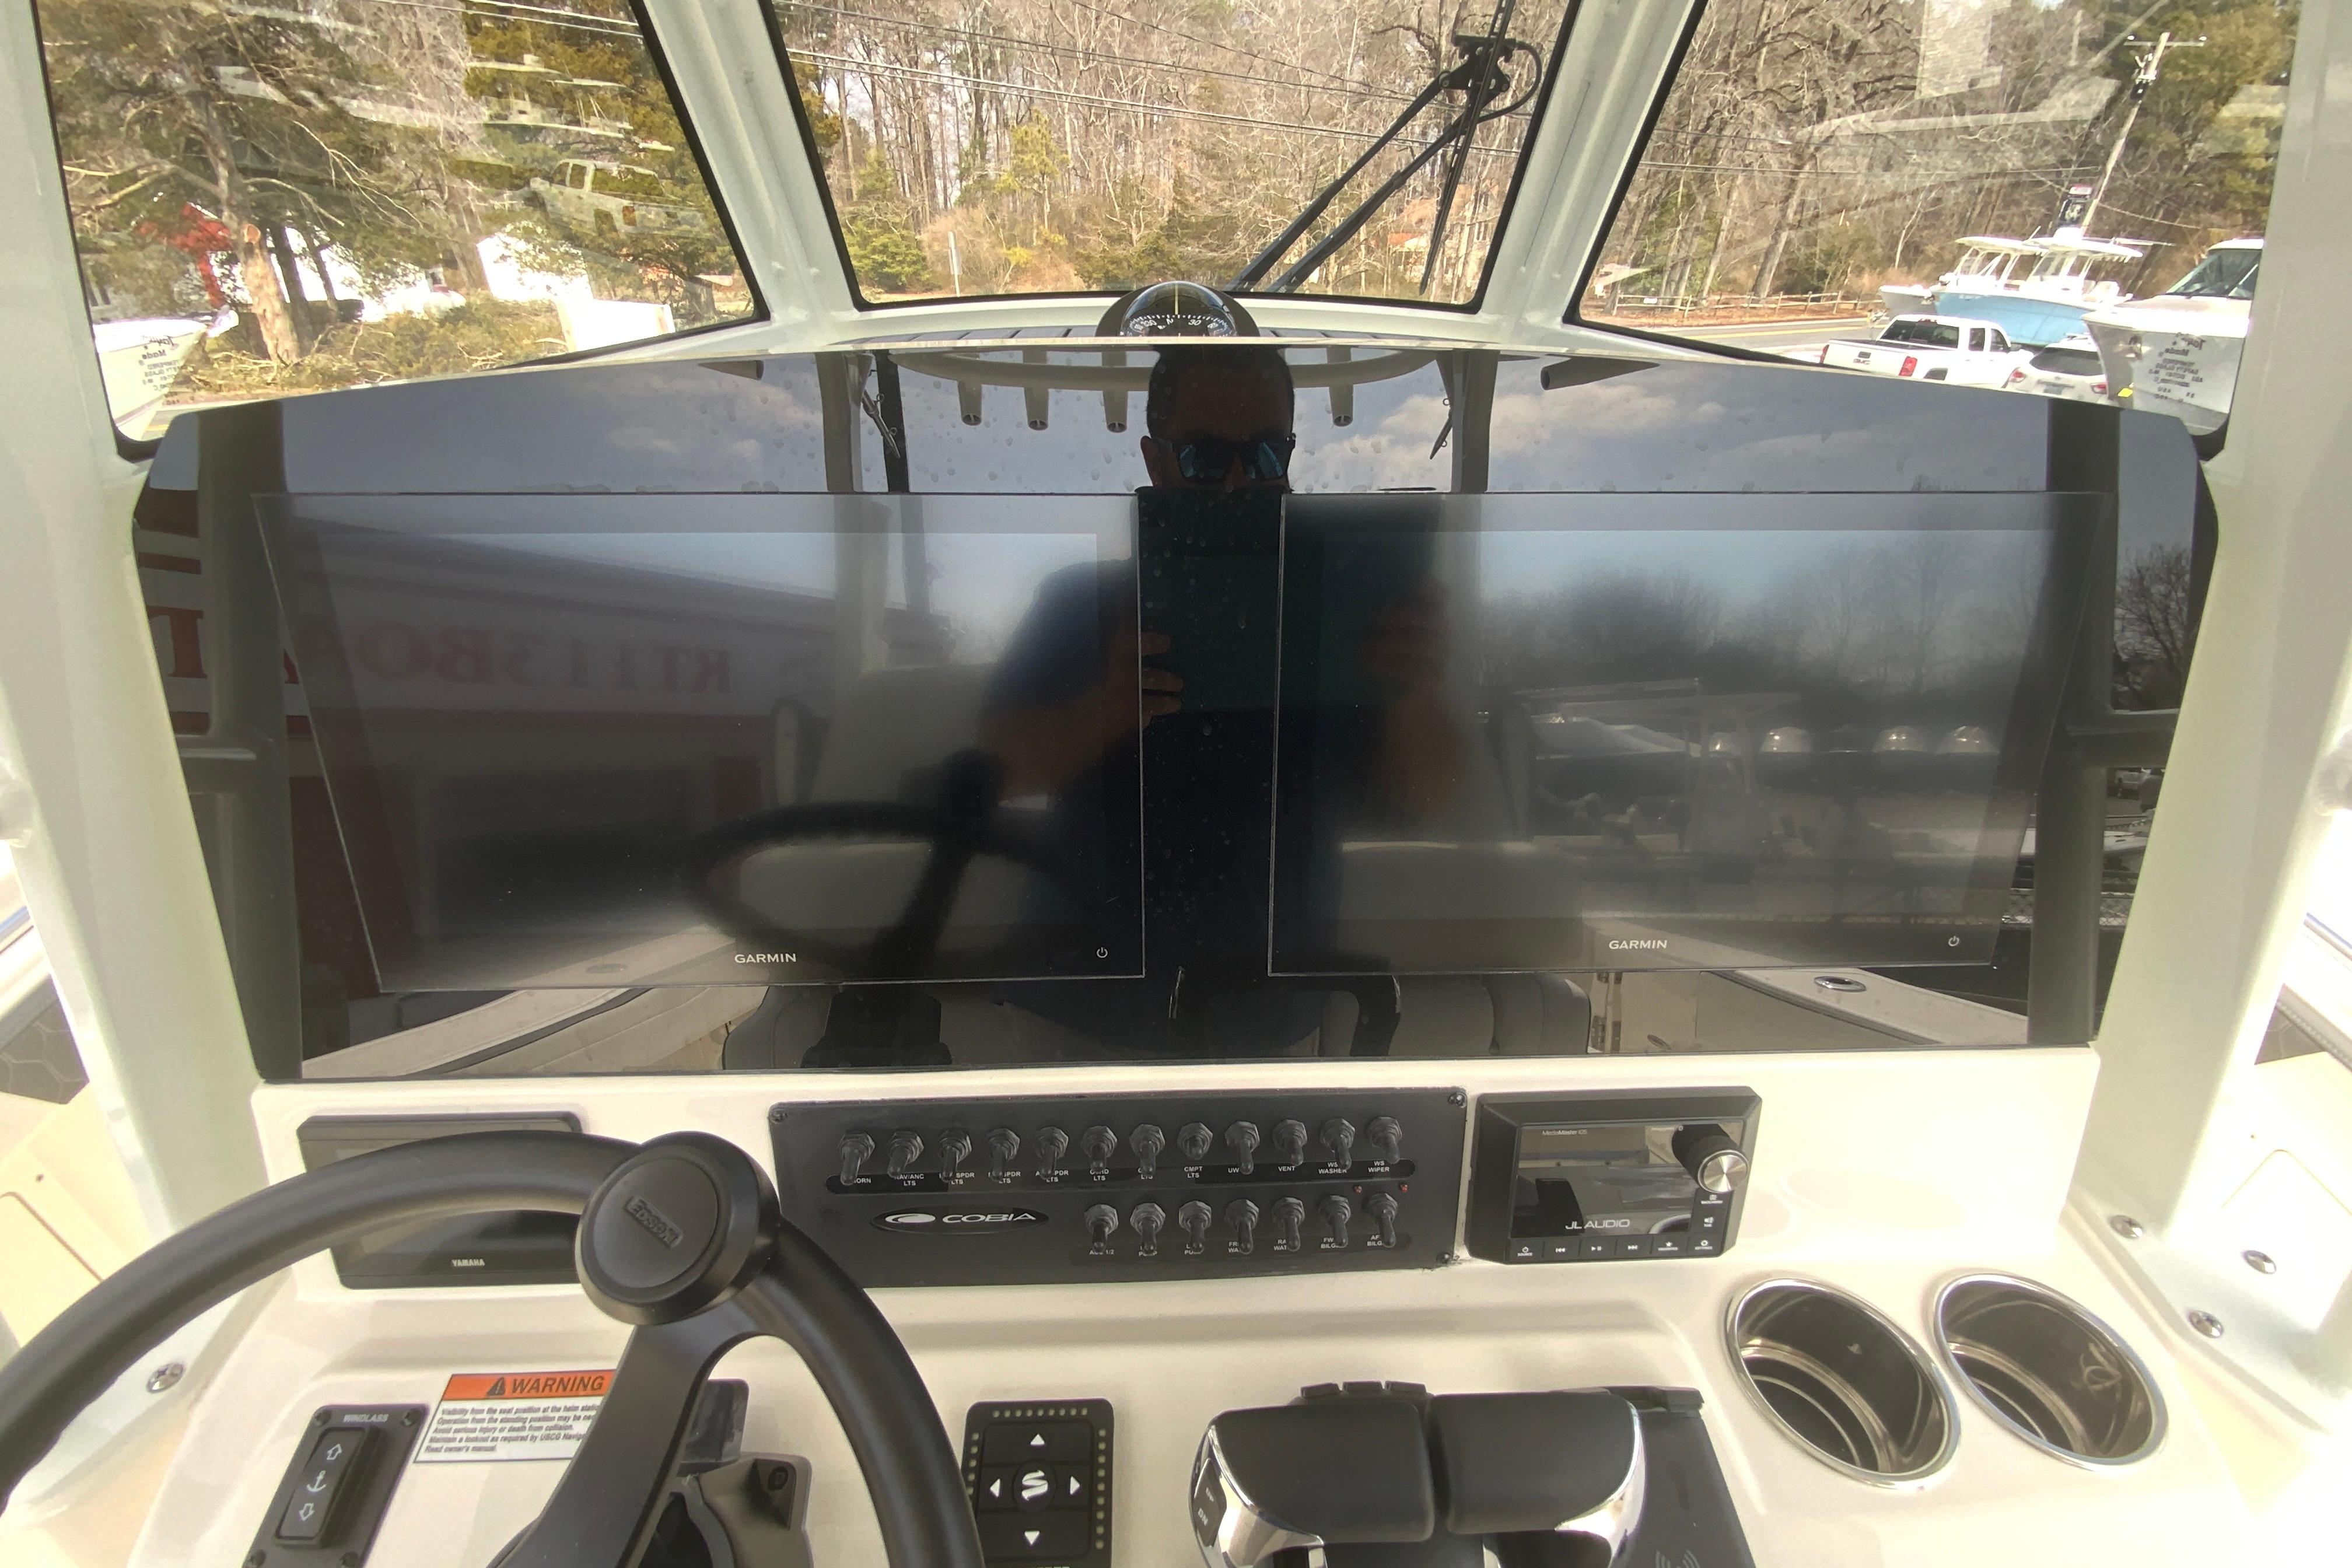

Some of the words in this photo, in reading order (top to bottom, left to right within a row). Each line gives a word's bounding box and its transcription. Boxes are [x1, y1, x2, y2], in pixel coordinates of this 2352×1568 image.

[1166, 317, 1174, 326] N
[1608, 940, 1668, 950] GARMIN
[734, 953, 797, 964] GARMIN
[942, 1213, 1037, 1223] COBIA
[1565, 1221, 1582, 1230] JL
[1583, 1219, 1630, 1229] AUDIO
[512, 1375, 605, 1394] WARNING
[530, 1434, 538, 1443] by
[540, 1433, 562, 1441] USCG
[1205, 1487, 1214, 1502] UP
[1198, 1507, 1209, 1527] DN
